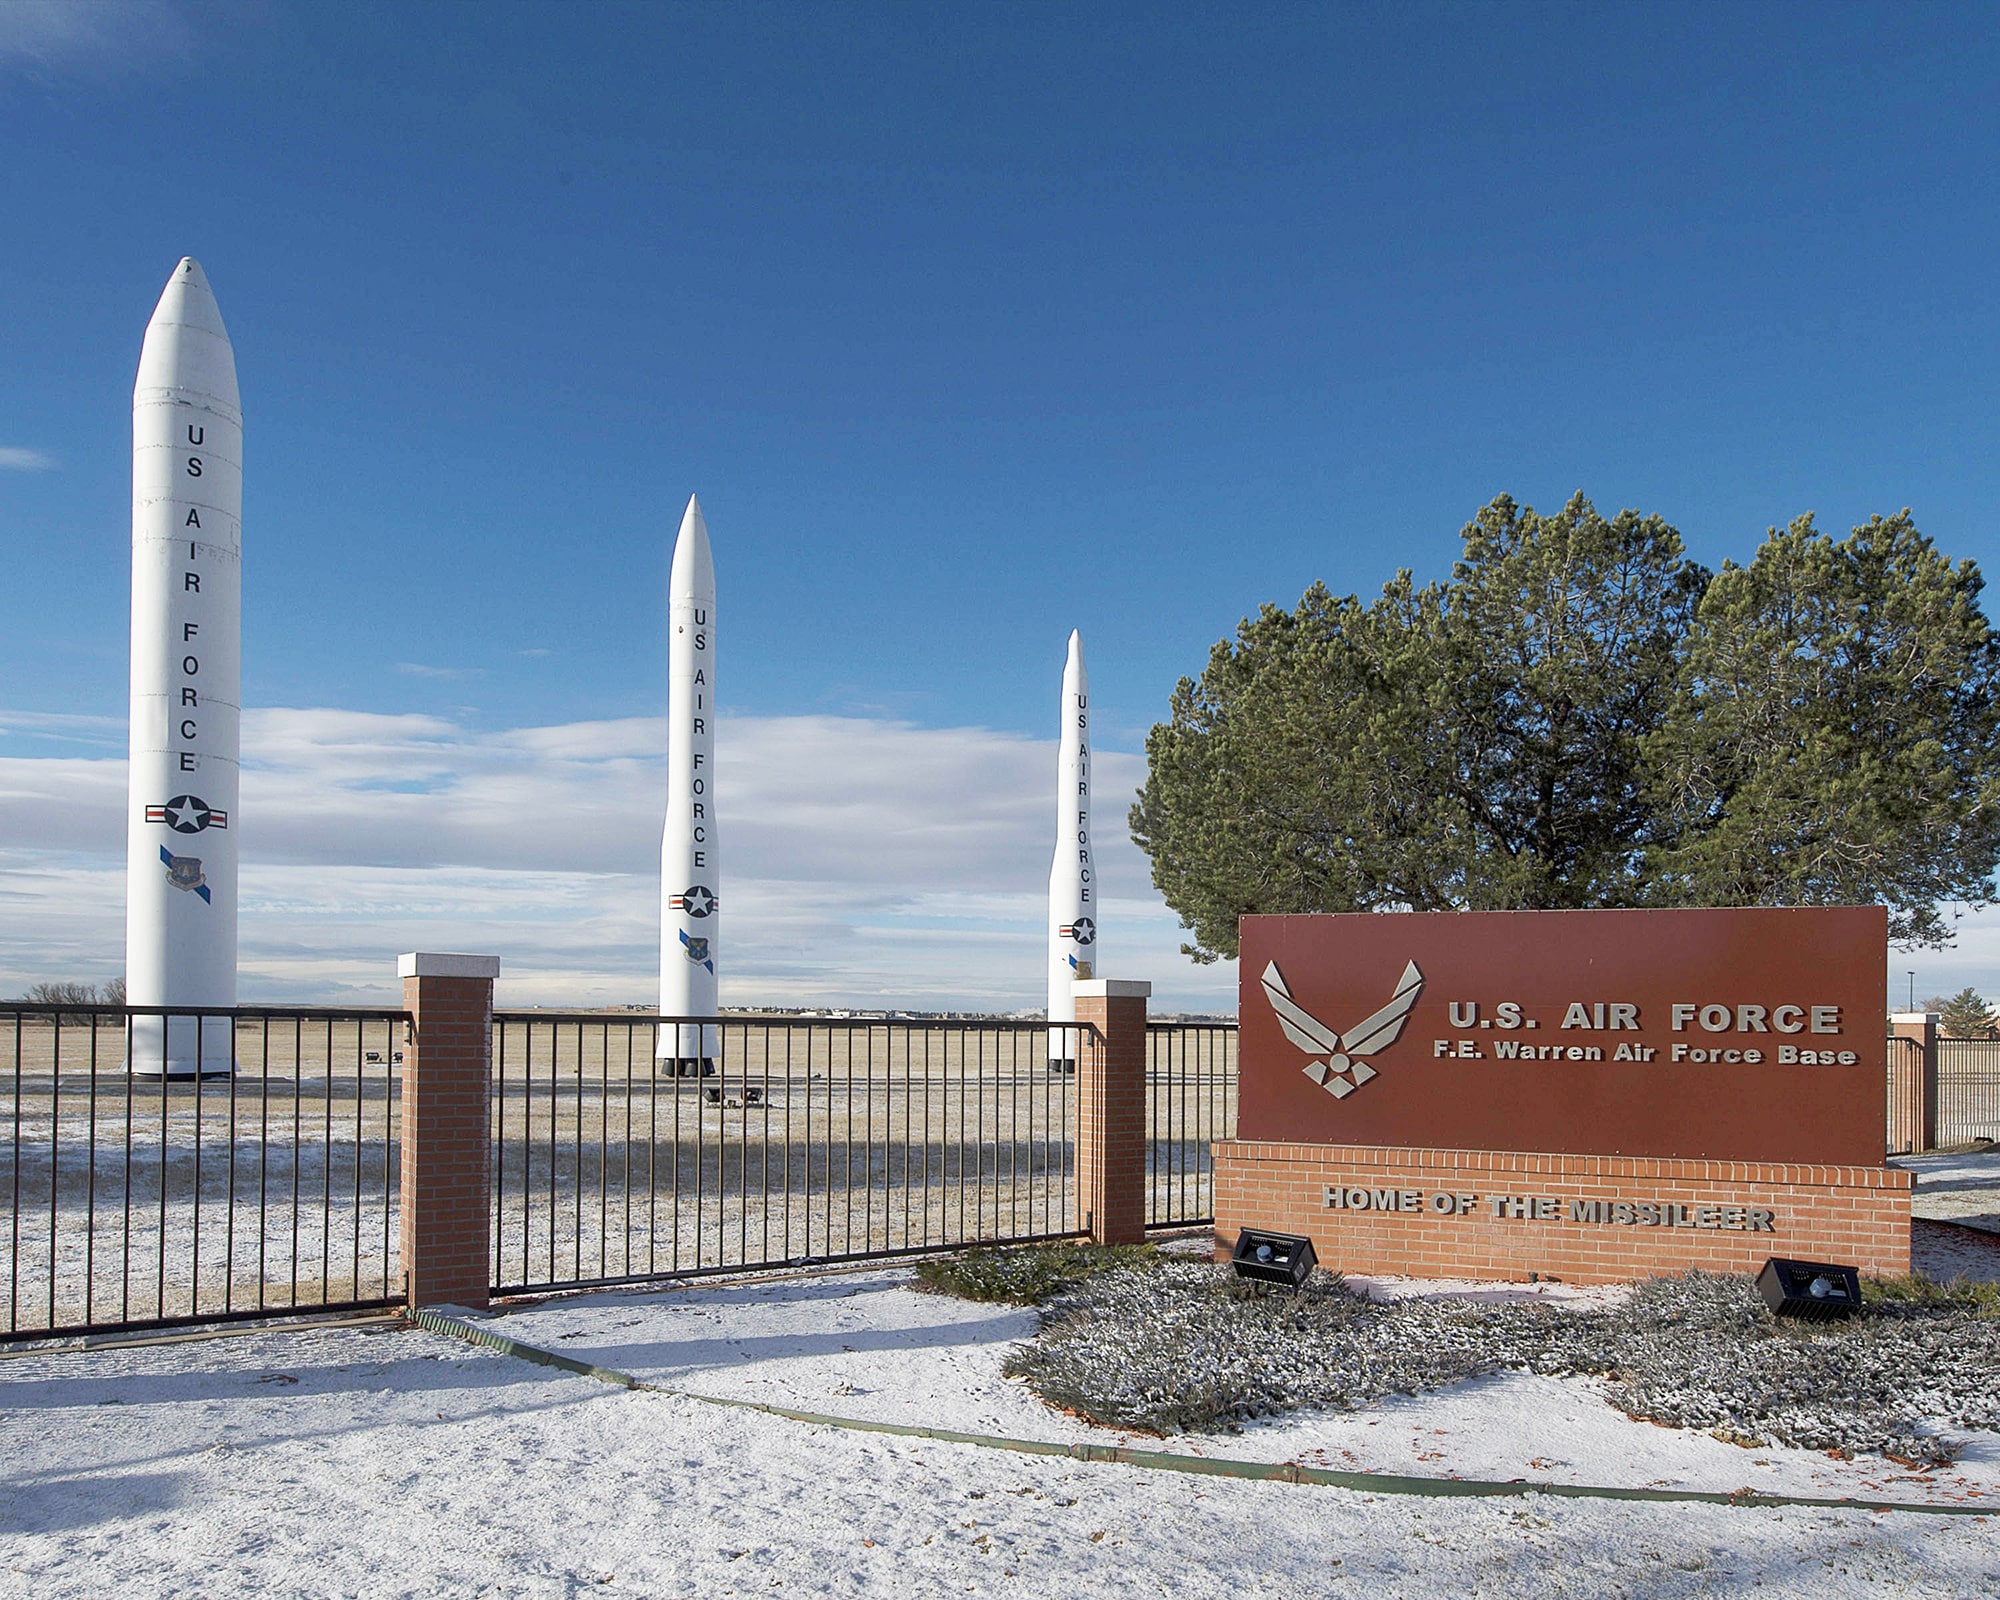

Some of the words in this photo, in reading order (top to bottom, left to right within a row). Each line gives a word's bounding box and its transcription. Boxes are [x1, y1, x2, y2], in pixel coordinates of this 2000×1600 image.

[187, 424, 204, 477] US
[185, 508, 201, 593] AIR
[694, 608, 706, 651] US
[180, 623, 199, 772] FORCE
[693, 668, 706, 735] AIR
[1078, 695, 1087, 729] US
[1078, 743, 1087, 796] AIR
[693, 753, 705, 868] FORCE
[1078, 811, 1090, 903] FORCE
[1448, 1001, 1537, 1029] U.S.
[1560, 1002, 1640, 1030] AIR
[1671, 1003, 1840, 1034] FORCE
[1434, 1039, 1483, 1059] F.E.
[1493, 1041, 1602, 1061] Warren
[1613, 1042, 1656, 1062] Air
[1671, 1043, 1763, 1064] Force
[1778, 1045, 1858, 1066] Base
[1322, 1186, 1421, 1212] HOME
[1430, 1192, 1477, 1215] OF
[1485, 1195, 1560, 1221] THE
[1568, 1199, 1774, 1232] MISSILEER
